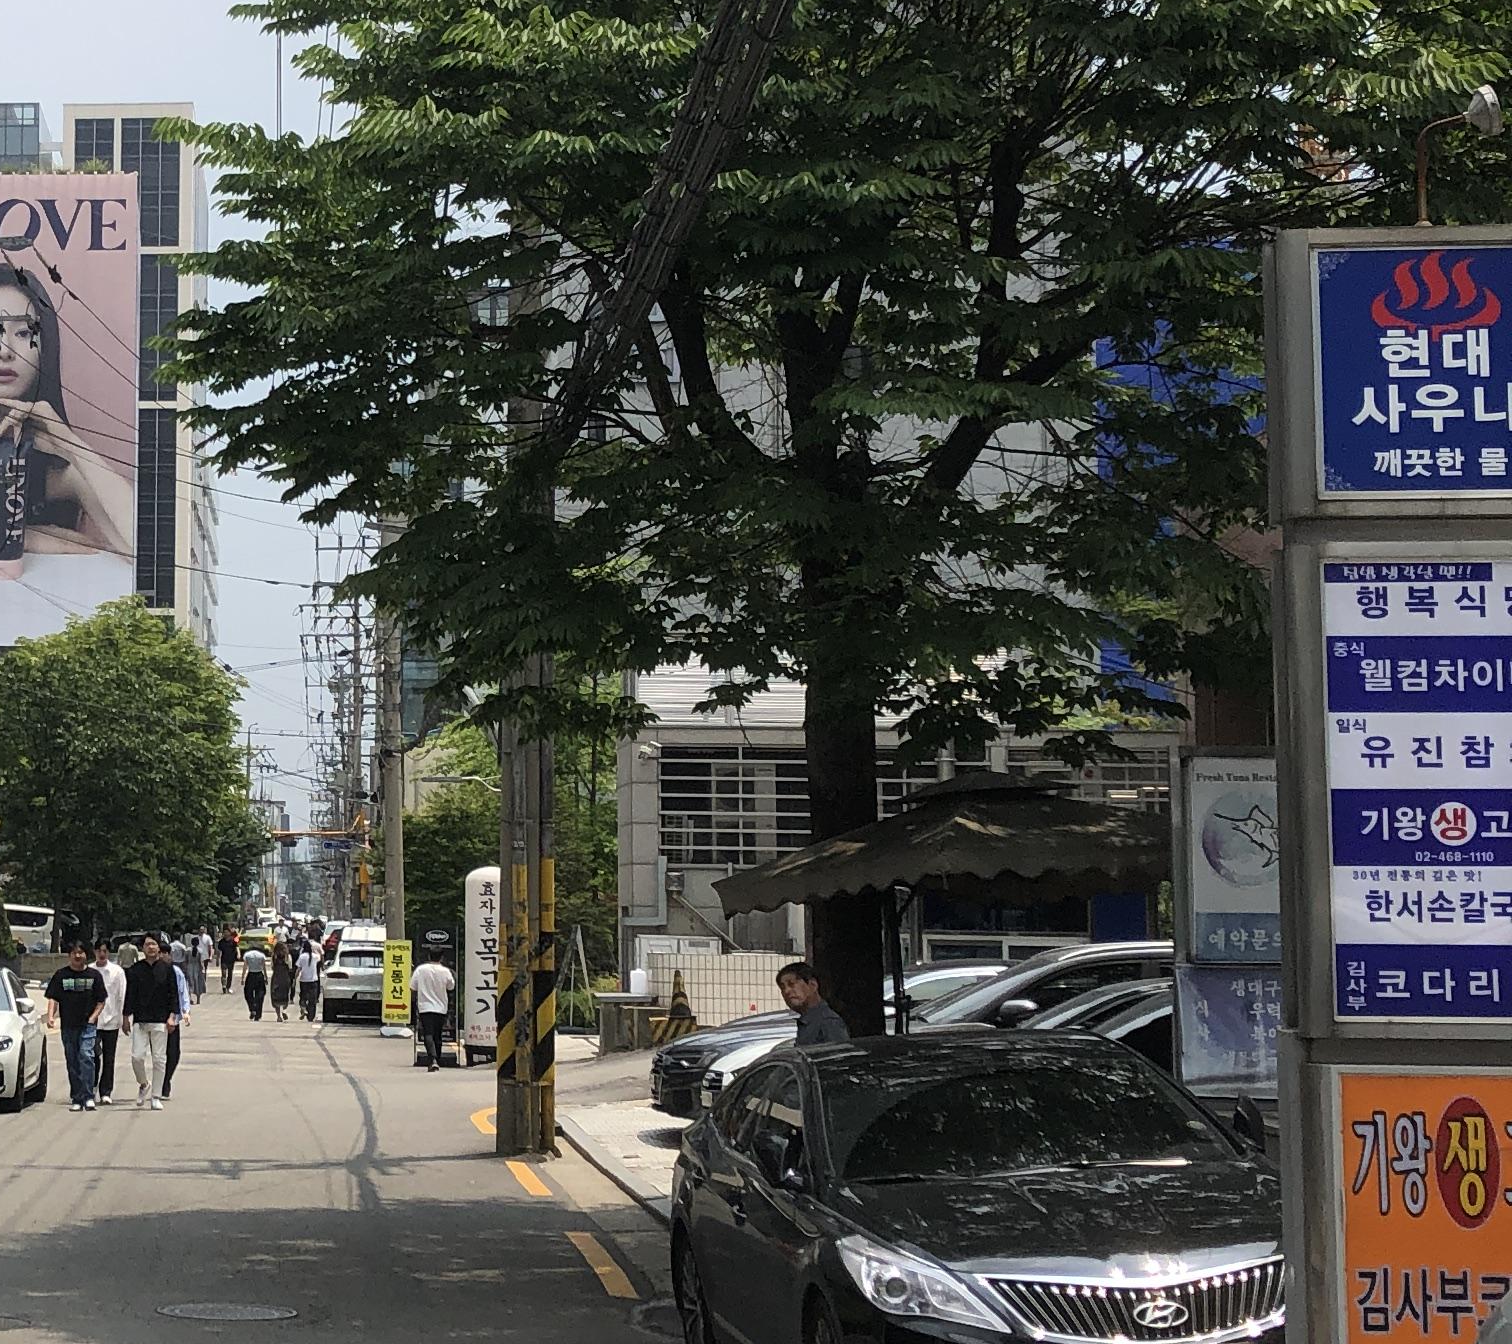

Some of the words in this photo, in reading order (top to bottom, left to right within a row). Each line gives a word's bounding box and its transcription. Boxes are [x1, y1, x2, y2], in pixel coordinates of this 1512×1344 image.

[1379, 328, 1490, 378] 현대
[1373, 447, 1465, 478] 깨끗한
[1478, 447, 1509, 476] 물
[1333, 641, 1365, 658] 중식
[1359, 658, 1512, 692] 웰컴차이
[1335, 718, 1367, 734] 일식
[1360, 735, 1512, 769] 유진참
[1415, 851, 1495, 862] 02-468-1110
[478, 881, 496, 935] 효자동
[391, 954, 405, 1000] 부동산
[1346, 960, 1368, 1011] 김사부
[1375, 968, 1501, 1003] 코다리
[1352, 1110, 1512, 1219] 기왕생
